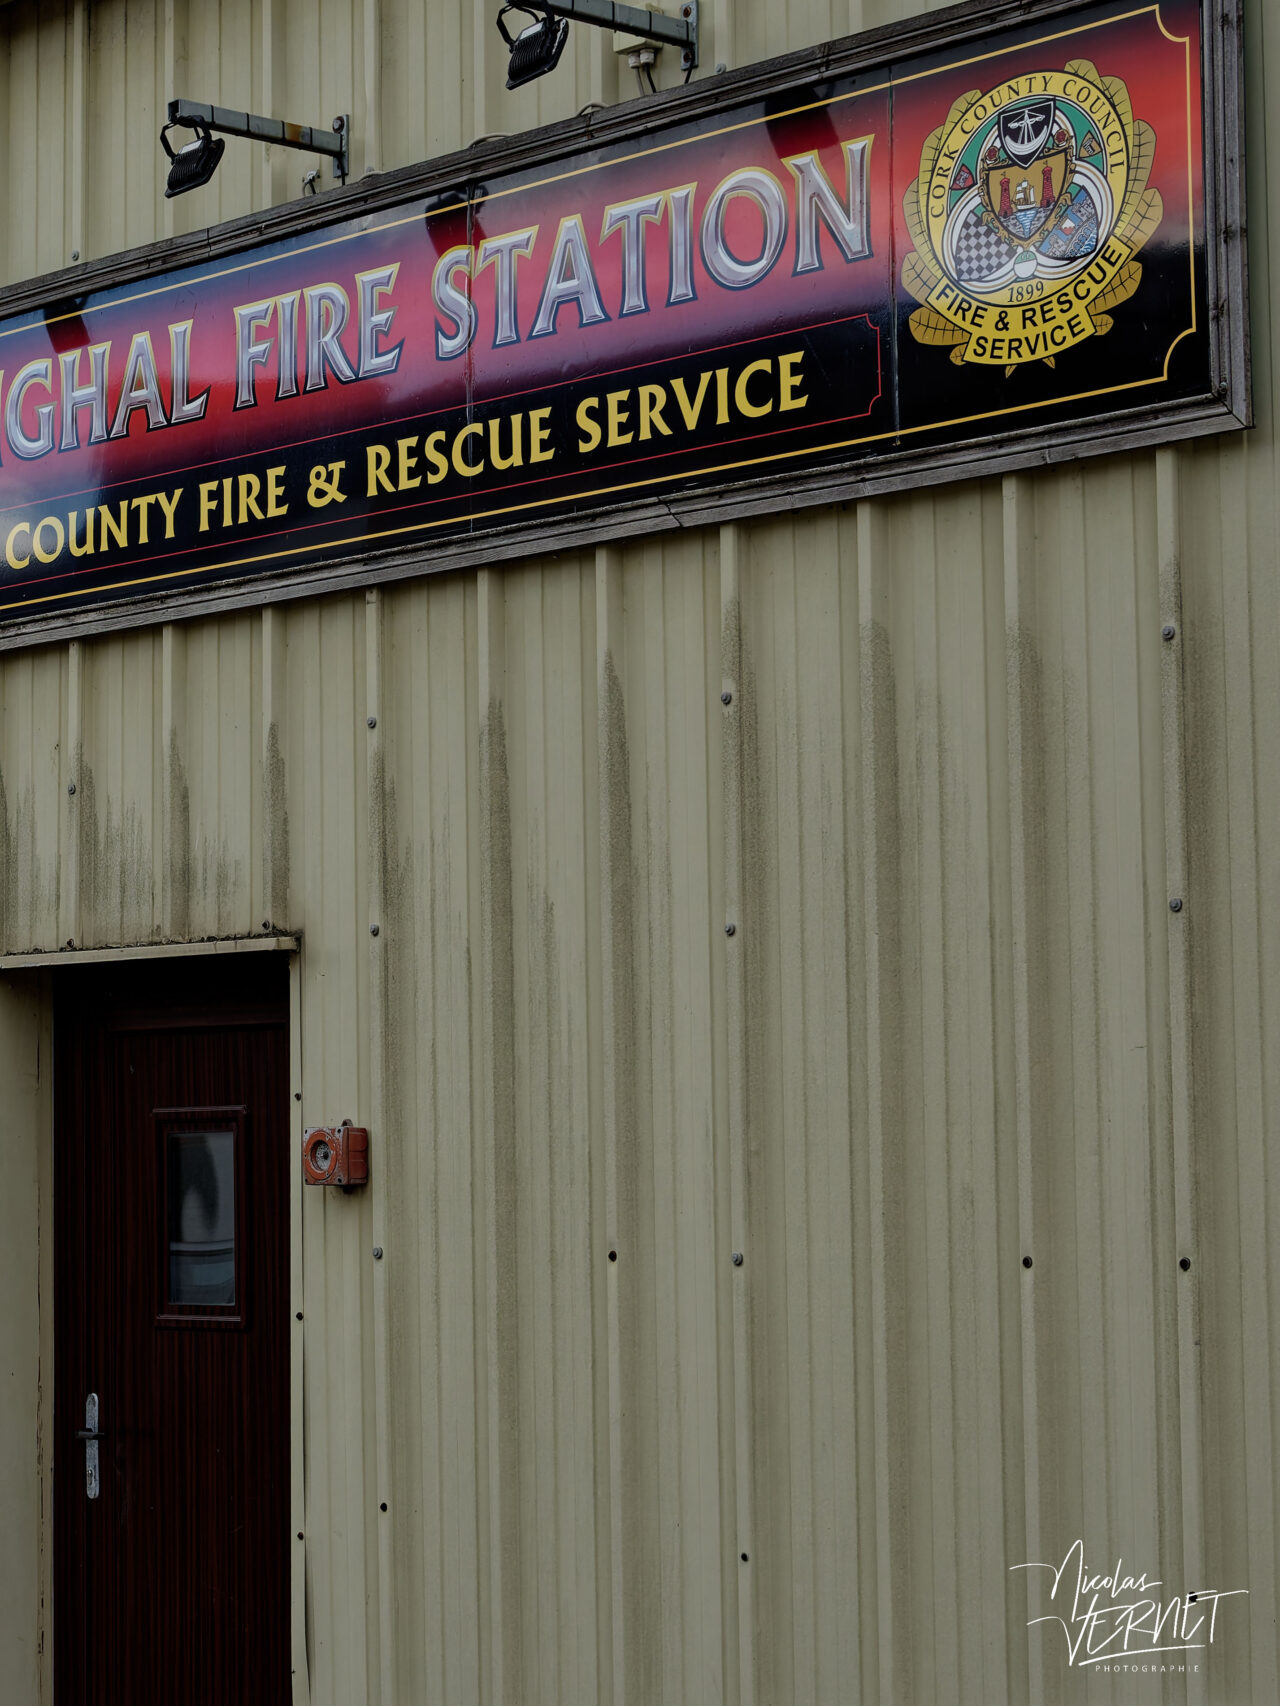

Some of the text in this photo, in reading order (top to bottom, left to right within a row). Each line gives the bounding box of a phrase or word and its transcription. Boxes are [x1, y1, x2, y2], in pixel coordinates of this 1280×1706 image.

[930, 75, 1126, 218] CORK COUNTY COUNCIL
[232, 262, 405, 412] FIRE
[432, 133, 876, 361] STATION
[935, 243, 1125, 332] FIRE & RESCUE
[1007, 281, 1045, 303] 1899
[972, 316, 1086, 360] SERVICE
[5, 487, 185, 570] COUNTY
[198, 465, 288, 533] FIRE
[306, 460, 347, 508] &
[366, 406, 555, 498] RESCUE
[576, 350, 810, 454] SERVICE
